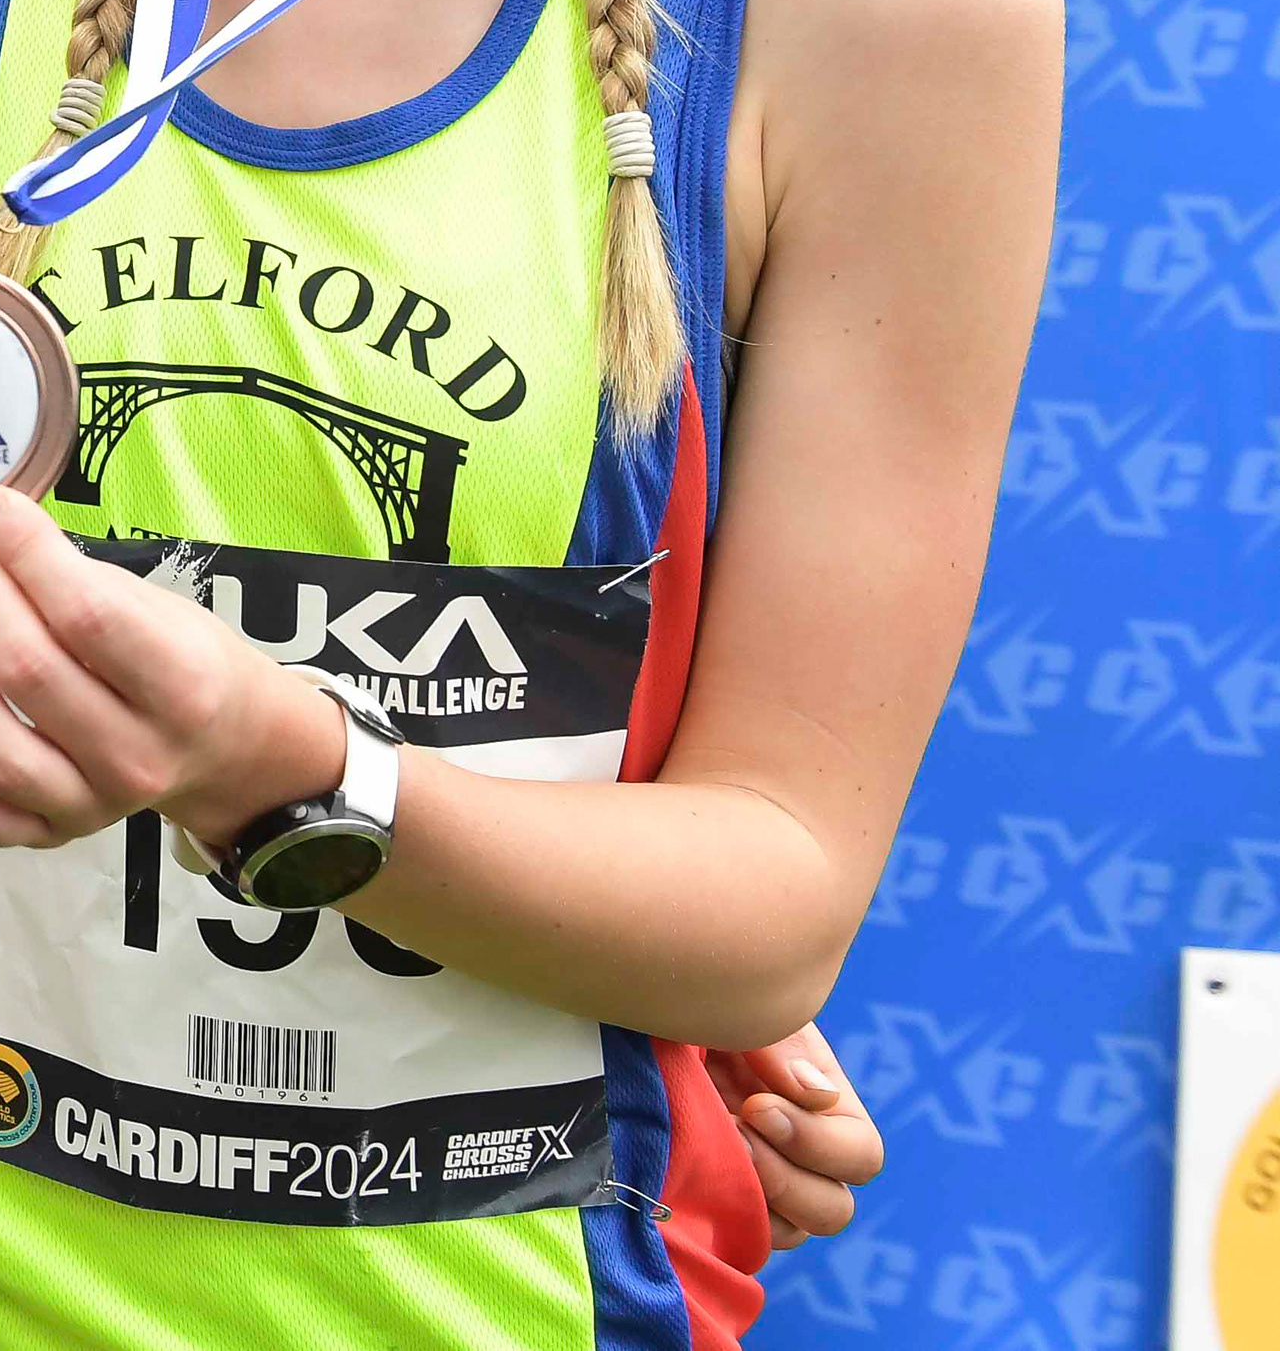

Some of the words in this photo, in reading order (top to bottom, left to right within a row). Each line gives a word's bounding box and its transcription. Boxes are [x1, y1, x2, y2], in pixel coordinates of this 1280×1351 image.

[212, 573, 529, 676] UKA
[448, 1127, 536, 1149] CARDIFF
[444, 1143, 533, 1168] CROSS
[442, 1161, 530, 1181] CHALLENGE
